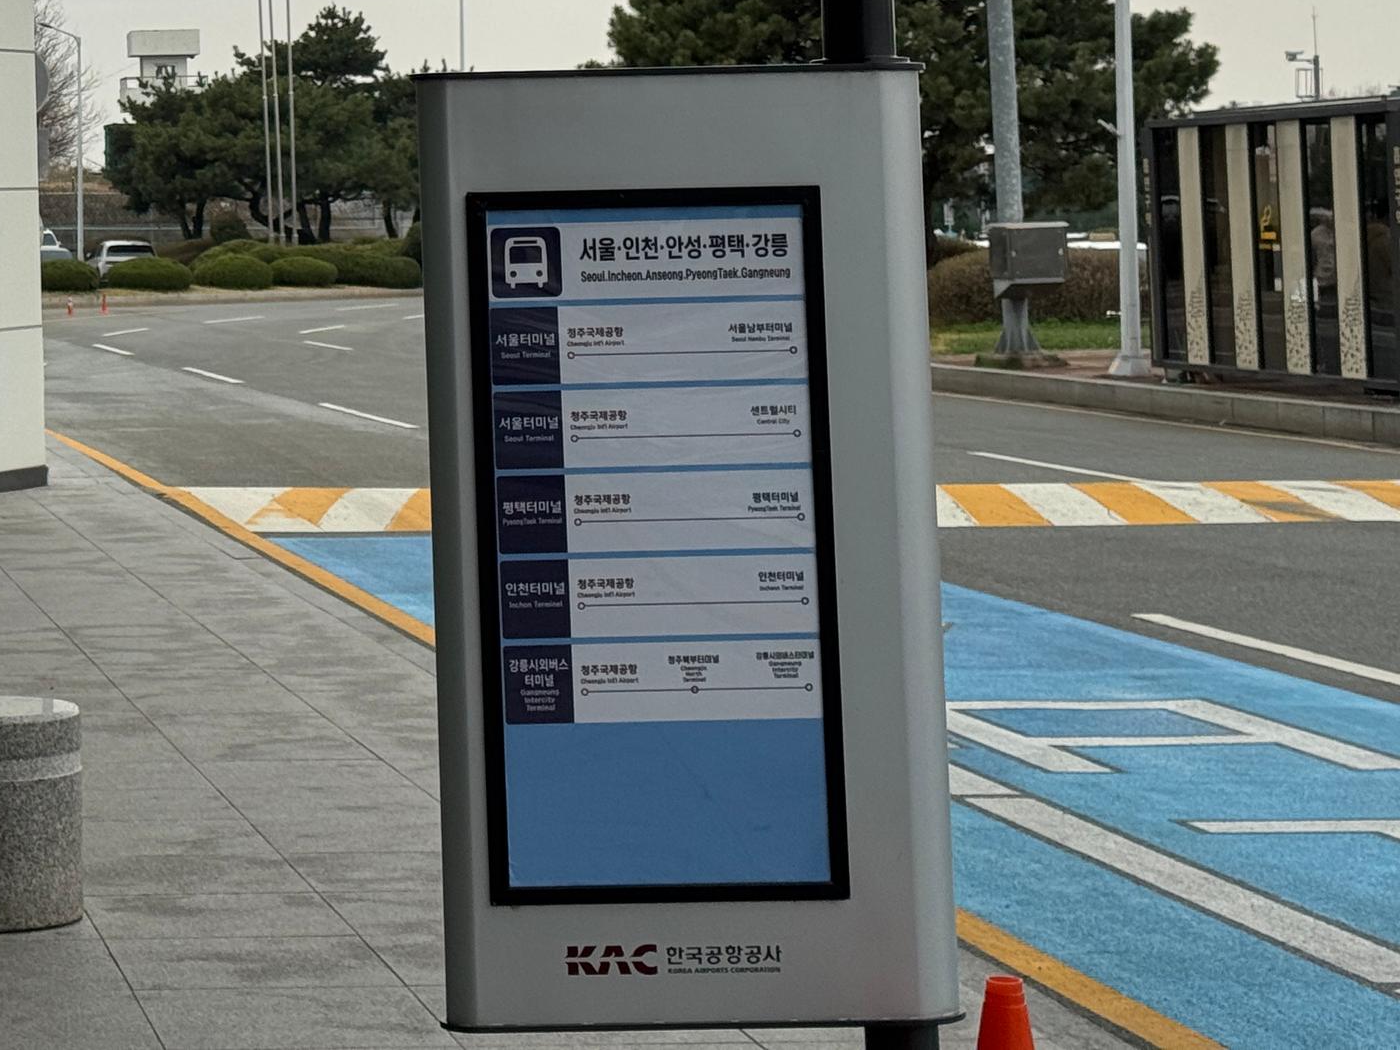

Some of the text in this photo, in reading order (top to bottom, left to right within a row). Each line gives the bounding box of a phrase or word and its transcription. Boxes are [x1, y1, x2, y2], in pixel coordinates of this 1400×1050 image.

[567, 327, 624, 339] 청주국제공항
[728, 322, 793, 334] 서울남부터미널
[496, 332, 556, 347] 서울터미널
[570, 410, 628, 422] 청주국제공항
[499, 416, 559, 431] 서울터미널
[574, 494, 631, 506] 청주국제공항
[752, 492, 799, 503] 평택터미널
[502, 501, 562, 515] 평택터미널
[758, 571, 804, 582] 인천터미널
[505, 581, 566, 596] 인천터미널
[577, 578, 635, 590] 청주국제공항
[509, 658, 569, 673] 강릉시외버스
[580, 665, 638, 676] 청주국제공항
[525, 674, 555, 687] 터미널
[565, 944, 658, 975] KAC
[666, 945, 782, 966] 한국공항공사
